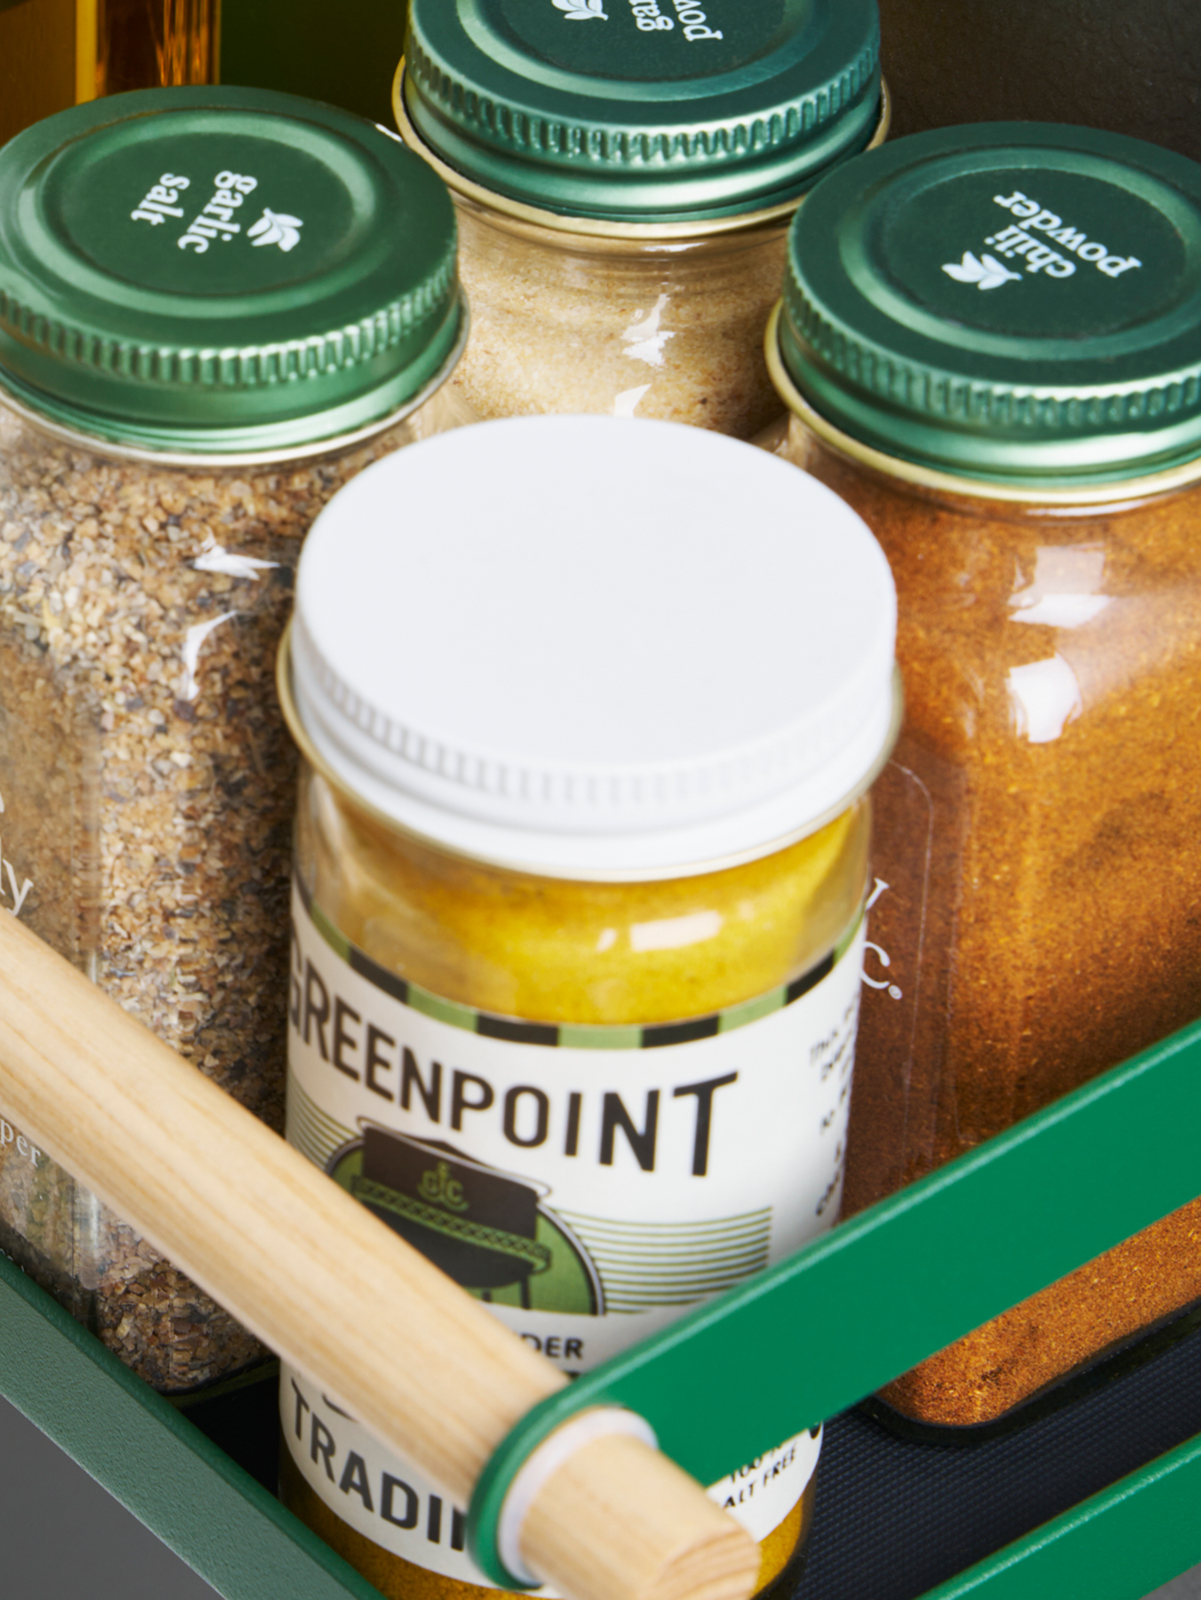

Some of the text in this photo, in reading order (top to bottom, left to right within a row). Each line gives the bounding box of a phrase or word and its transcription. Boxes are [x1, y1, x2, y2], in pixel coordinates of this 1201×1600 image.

[130, 172, 191, 226] salt
[177, 169, 258, 254] garlic
[984, 224, 1077, 278] chili
[993, 191, 1142, 278] powder
[520, 1333, 584, 1360] DER
[722, 1441, 798, 1509] ALT FREE
